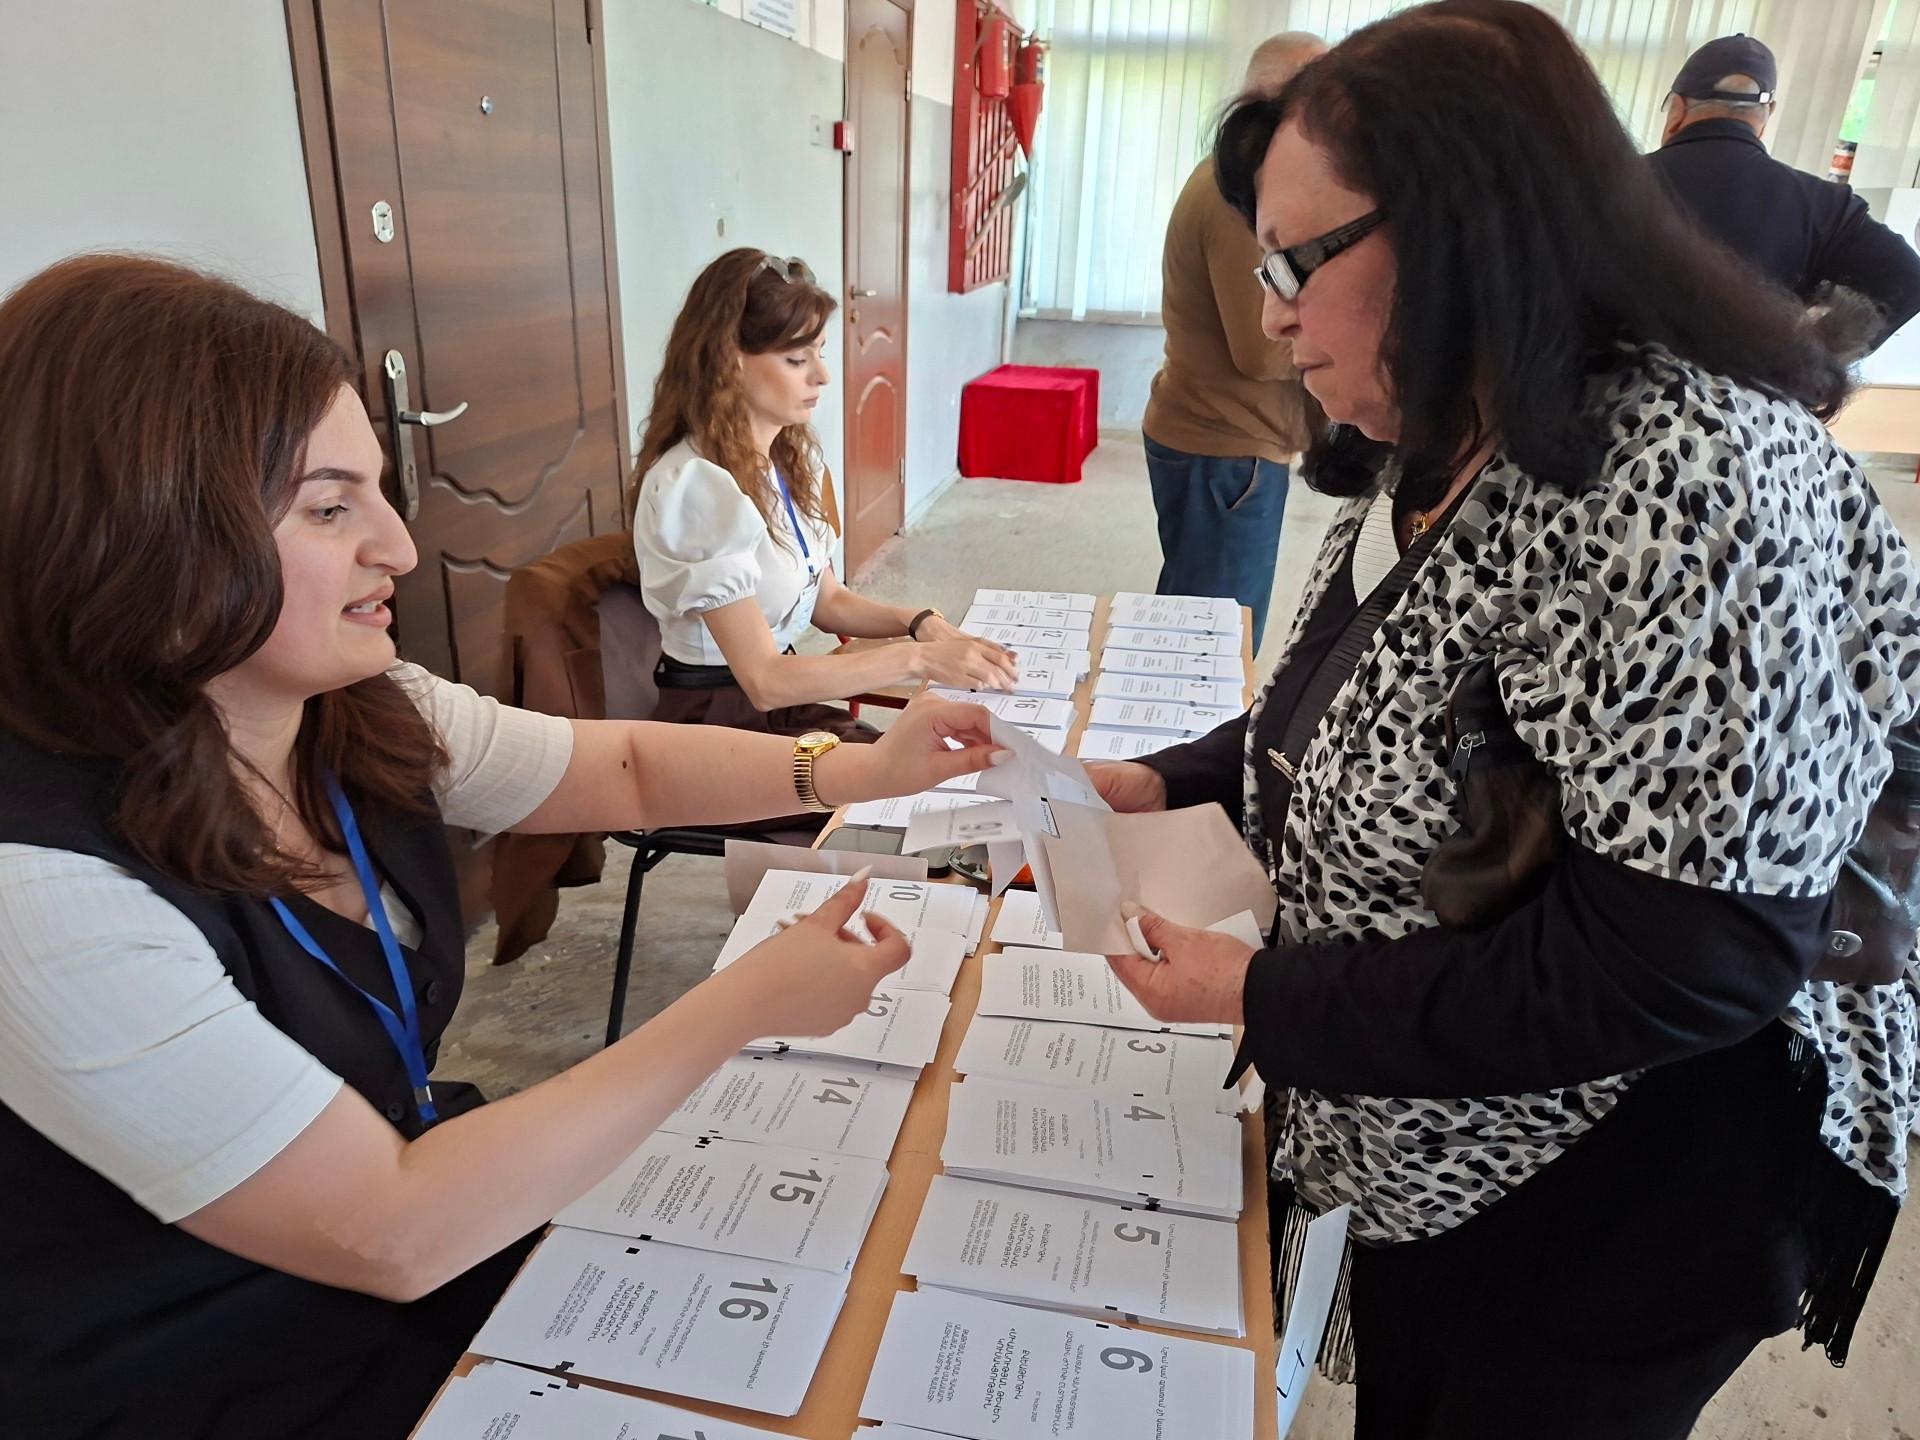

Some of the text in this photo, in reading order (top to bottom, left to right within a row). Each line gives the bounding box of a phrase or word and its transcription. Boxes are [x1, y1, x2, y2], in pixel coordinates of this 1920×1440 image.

[1042, 630, 1063, 638] 12
[1044, 651, 1065, 660] 14
[1026, 669, 1049, 679] 15
[1014, 698, 1040, 709] 16
[889, 883, 924, 901] 10
[865, 992, 893, 1017] 12
[1127, 1040, 1166, 1053] 3
[813, 1078, 859, 1104] 14
[1124, 1106, 1165, 1121] 4
[770, 1170, 821, 1204] 15
[1114, 1223, 1160, 1245] 5
[719, 1278, 777, 1320] 16
[1100, 1347, 1152, 1373] 6
[984, 1338, 1004, 1408] ԿՈՒՍԱԿՑՈՒԹՅՈՒՆ
[992, 1328, 1016, 1423] «ՄԻԱՍՆՈՒԹՅԱՆ ԹԵՎԵՐ»
[1014, 1350, 1030, 1399] ՔՎԵԱԹԵՐԹԻԿ
[1156, 1418, 1164, 1440] կատա
